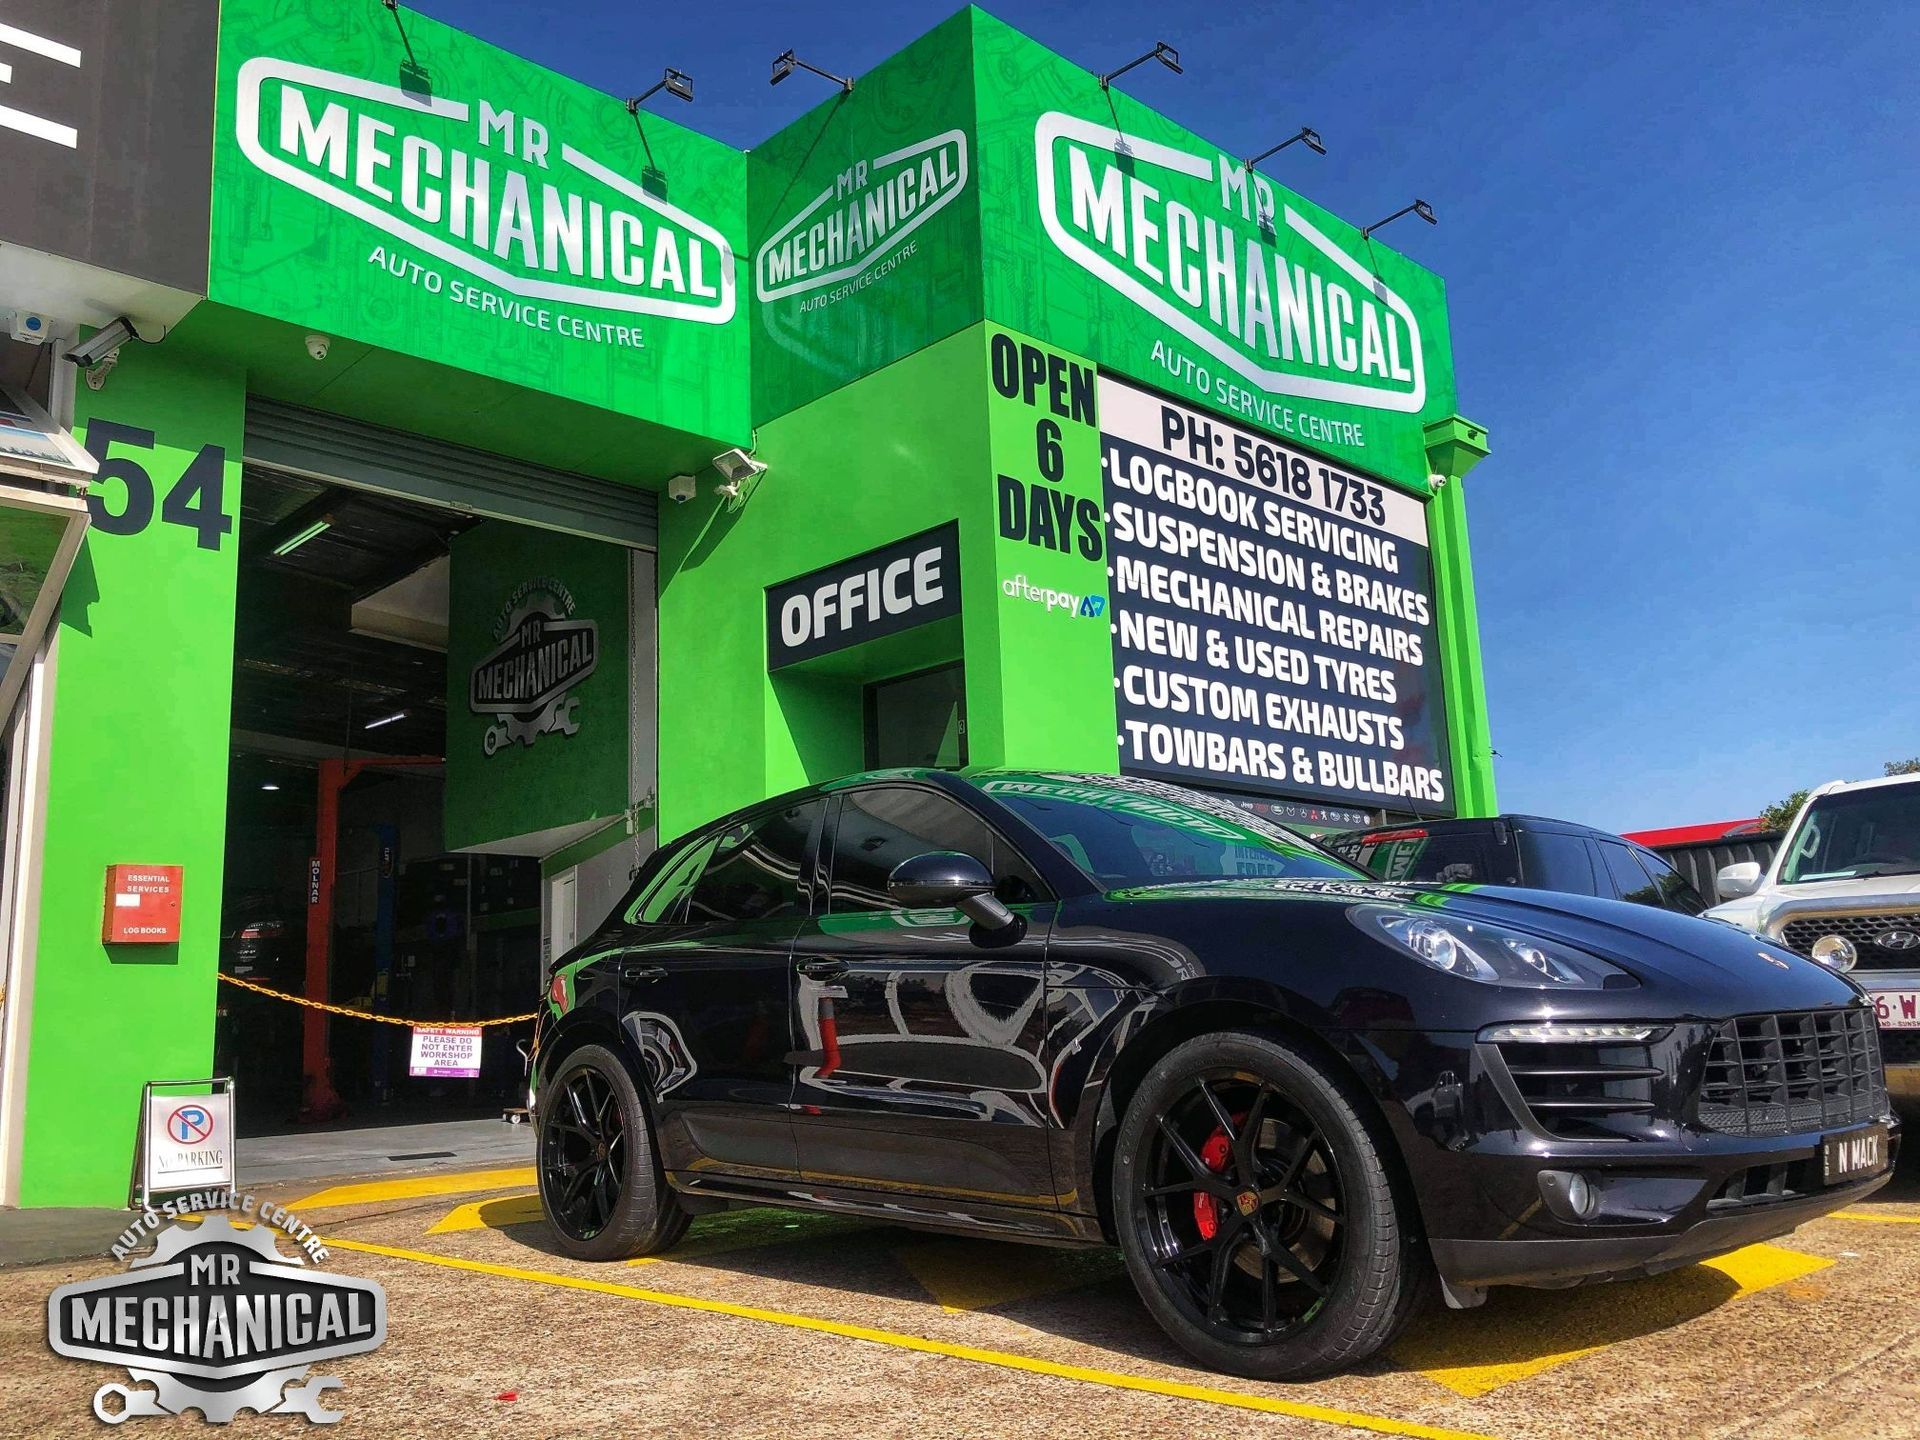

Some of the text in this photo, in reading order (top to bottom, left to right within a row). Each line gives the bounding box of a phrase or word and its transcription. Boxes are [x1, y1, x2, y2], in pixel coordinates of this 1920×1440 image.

[478, 99, 550, 171] MR
[280, 85, 718, 299] MECHANICAL
[768, 147, 957, 286] MECHANICAL
[836, 160, 868, 202] MR
[1220, 154, 1276, 233] MR
[368, 245, 645, 349] AUTO SERVICE CENTRE
[799, 241, 918, 314] AUTO SERVICE CENTRE
[1069, 144, 1412, 381] MECHANICAL
[991, 333, 1098, 429] OPEN
[1151, 339, 1365, 447] AUTO SERVICE CENTRE
[83, 417, 233, 552] 54
[1036, 418, 1064, 483] 6
[1161, 406, 1386, 527] PH: 5618 1733
[997, 474, 1103, 563] DAYS
[1109, 447, 1399, 575] LOGBOOK SERVICING
[781, 546, 944, 647] OFFICE
[1002, 574, 1081, 619] afterpay
[1114, 503, 1430, 627] SUSPENSION & BRAKES
[521, 618, 541, 649] MR
[1116, 555, 1424, 667] MECHANICAL REPAIRS
[478, 631, 592, 699] MECHANICAL
[1120, 609, 1398, 705] NEW & USED TYRES
[1122, 665, 1405, 751] CUSTOM EXHAUSTS
[1125, 721, 1445, 804] TOWBARS & BULLBARS
[126, 885, 169, 893] SERVICES
[127, 874, 171, 883] ESSENTIAL
[311, 860, 320, 904] MOLNAR
[416, 1027, 444, 1035] SAFETY
[420, 1051, 473, 1059] WORKSHOP
[423, 1036, 456, 1044] PLEASE
[178, 1148, 223, 1167] PARKING
[1839, 1134, 1879, 1174] N MACK
